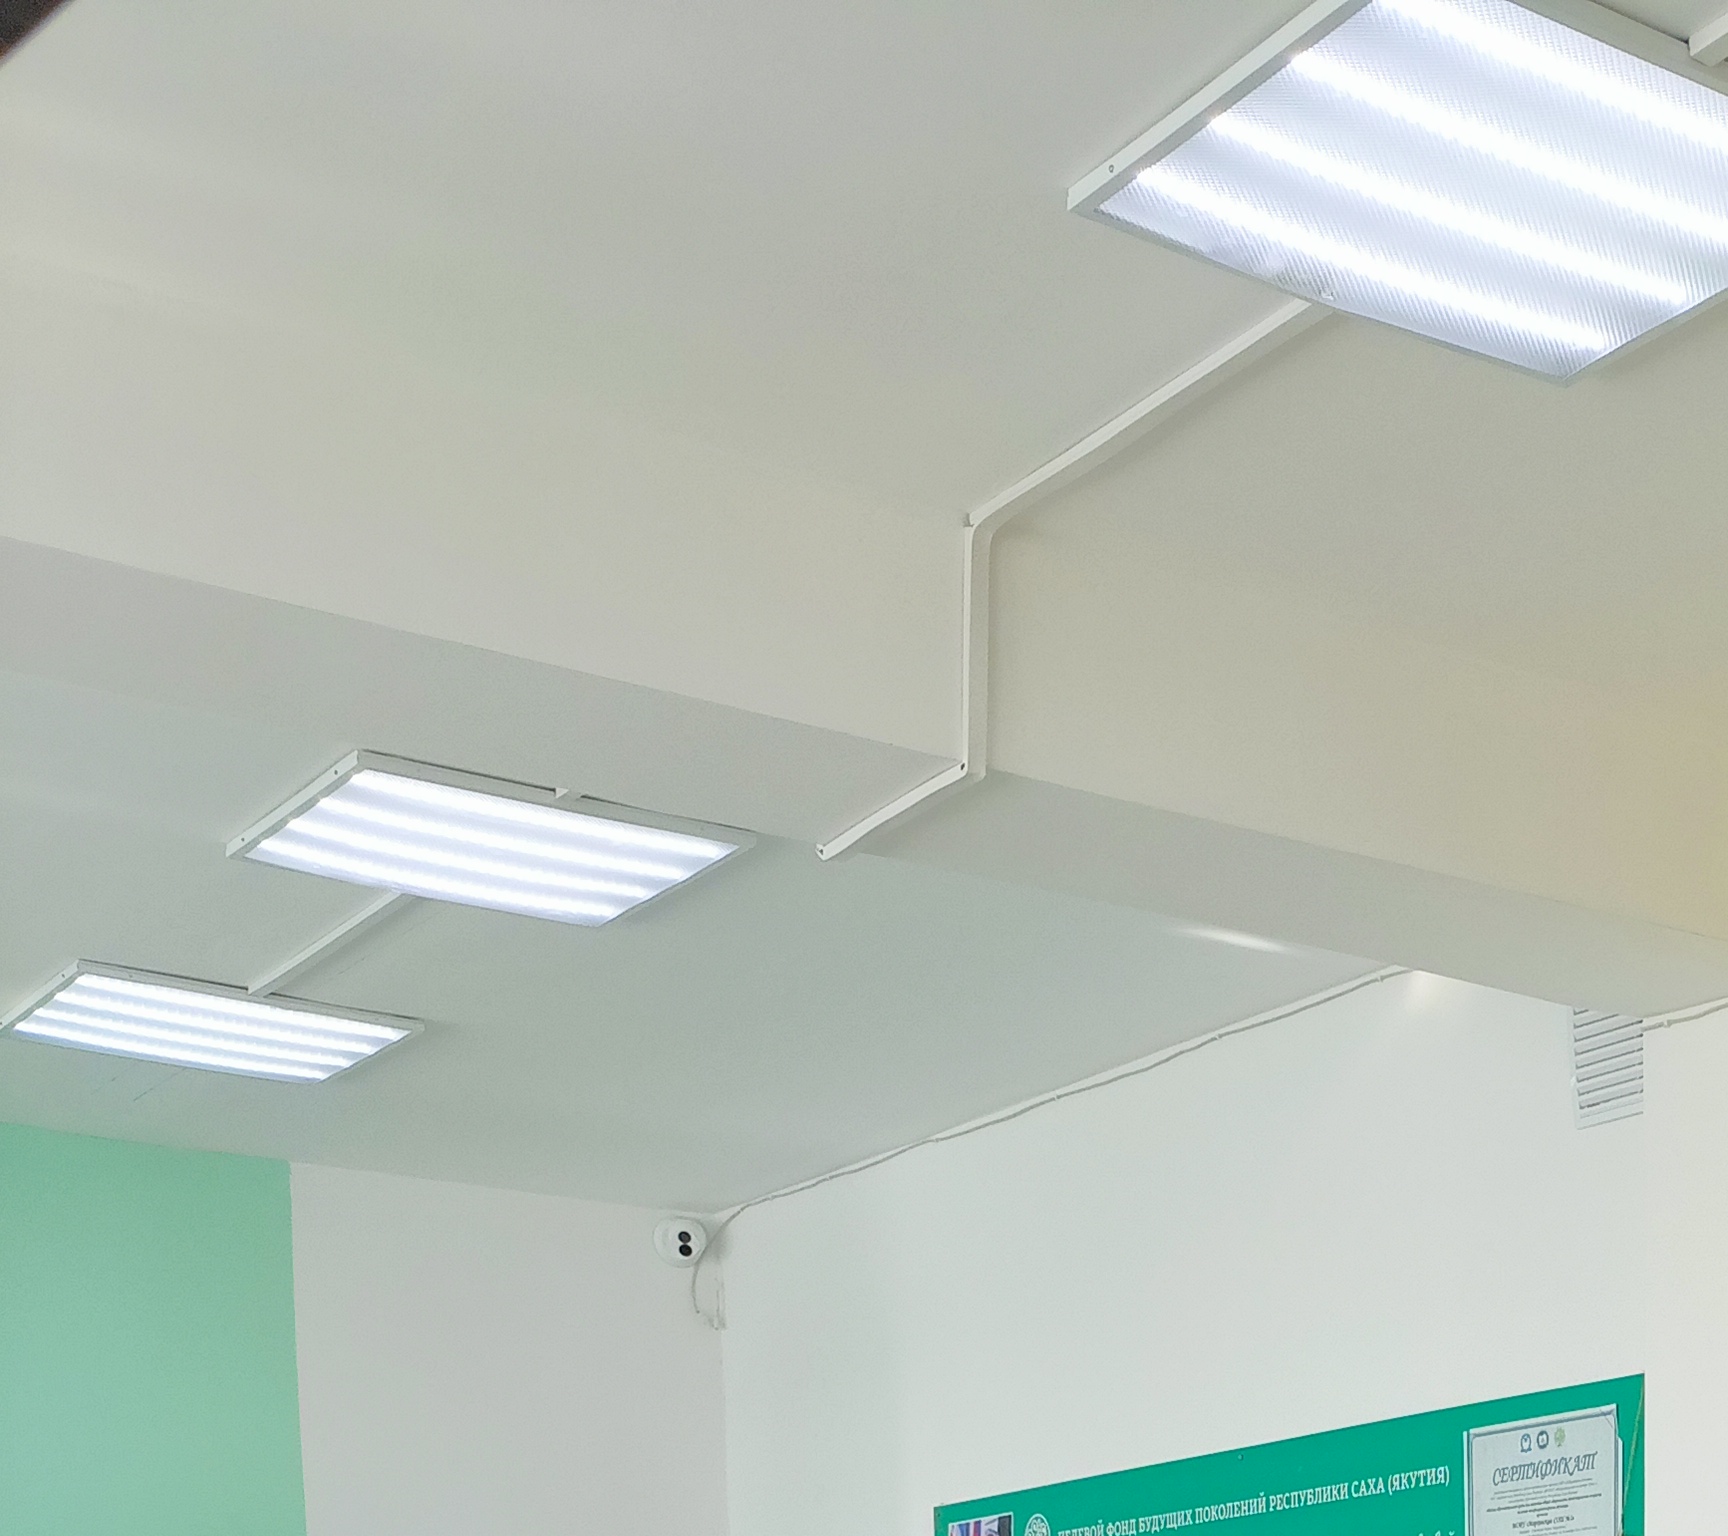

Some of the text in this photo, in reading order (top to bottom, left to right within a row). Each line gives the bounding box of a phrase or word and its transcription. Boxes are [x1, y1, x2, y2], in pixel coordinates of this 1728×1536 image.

[1492, 1451, 1598, 1486] СЕРТИФИКАТ
[1106, 1519, 1136, 1536] ФОНД
[1138, 1509, 1192, 1534] БУДУЩИХ
[1195, 1492, 1266, 1523] ПОКОЛЕНИЙ
[1269, 1483, 1349, 1511] РЕСПУБЛИКИ
[1351, 1477, 1384, 1498] САХА
[1388, 1465, 1450, 1495] (ЯКУТИЯ)
